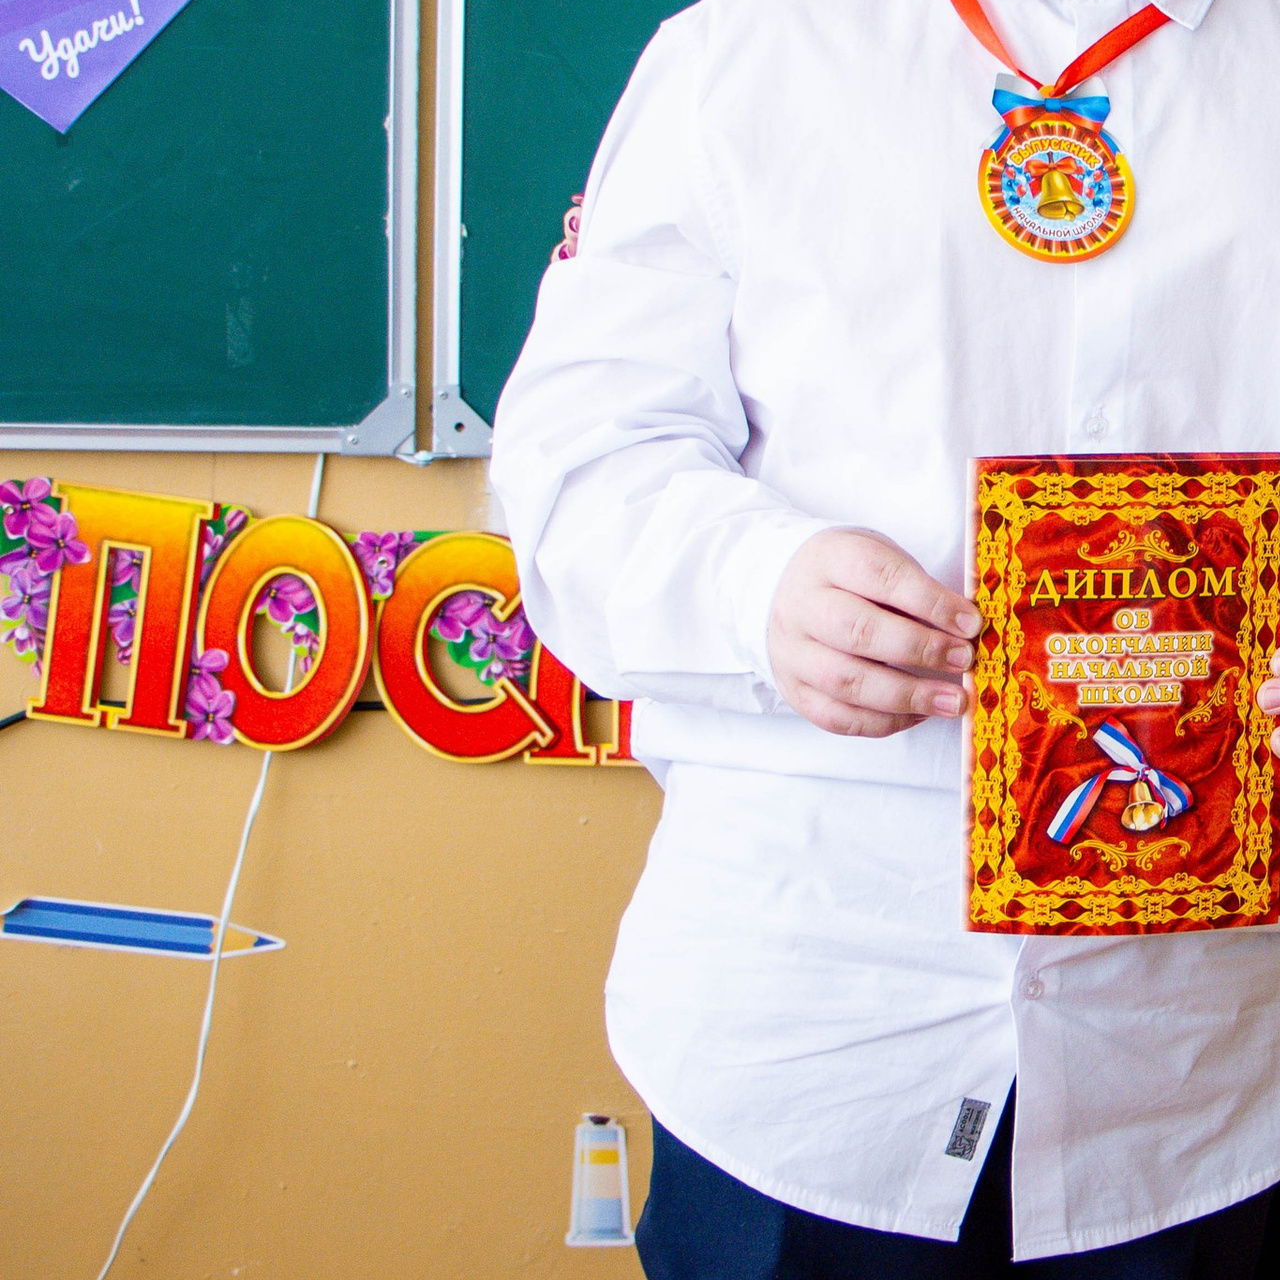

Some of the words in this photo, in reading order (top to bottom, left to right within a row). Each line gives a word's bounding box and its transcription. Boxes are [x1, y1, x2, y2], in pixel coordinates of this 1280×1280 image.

[1010, 137, 1102, 168] ВЫПУСКНИК
[1013, 207, 1071, 238] НАЧАЛЬНОЙ
[1072, 208, 1105, 237] ШКОЛЫ
[1029, 566, 1237, 607] ДИПЛОМ
[1115, 610, 1149, 630] ОБ
[1048, 633, 1212, 655] ОКОНЧАНИИ
[1050, 655, 1209, 680] НАЧАЛЬНОЙ
[1080, 683, 1181, 705] ШКОЛЫ
